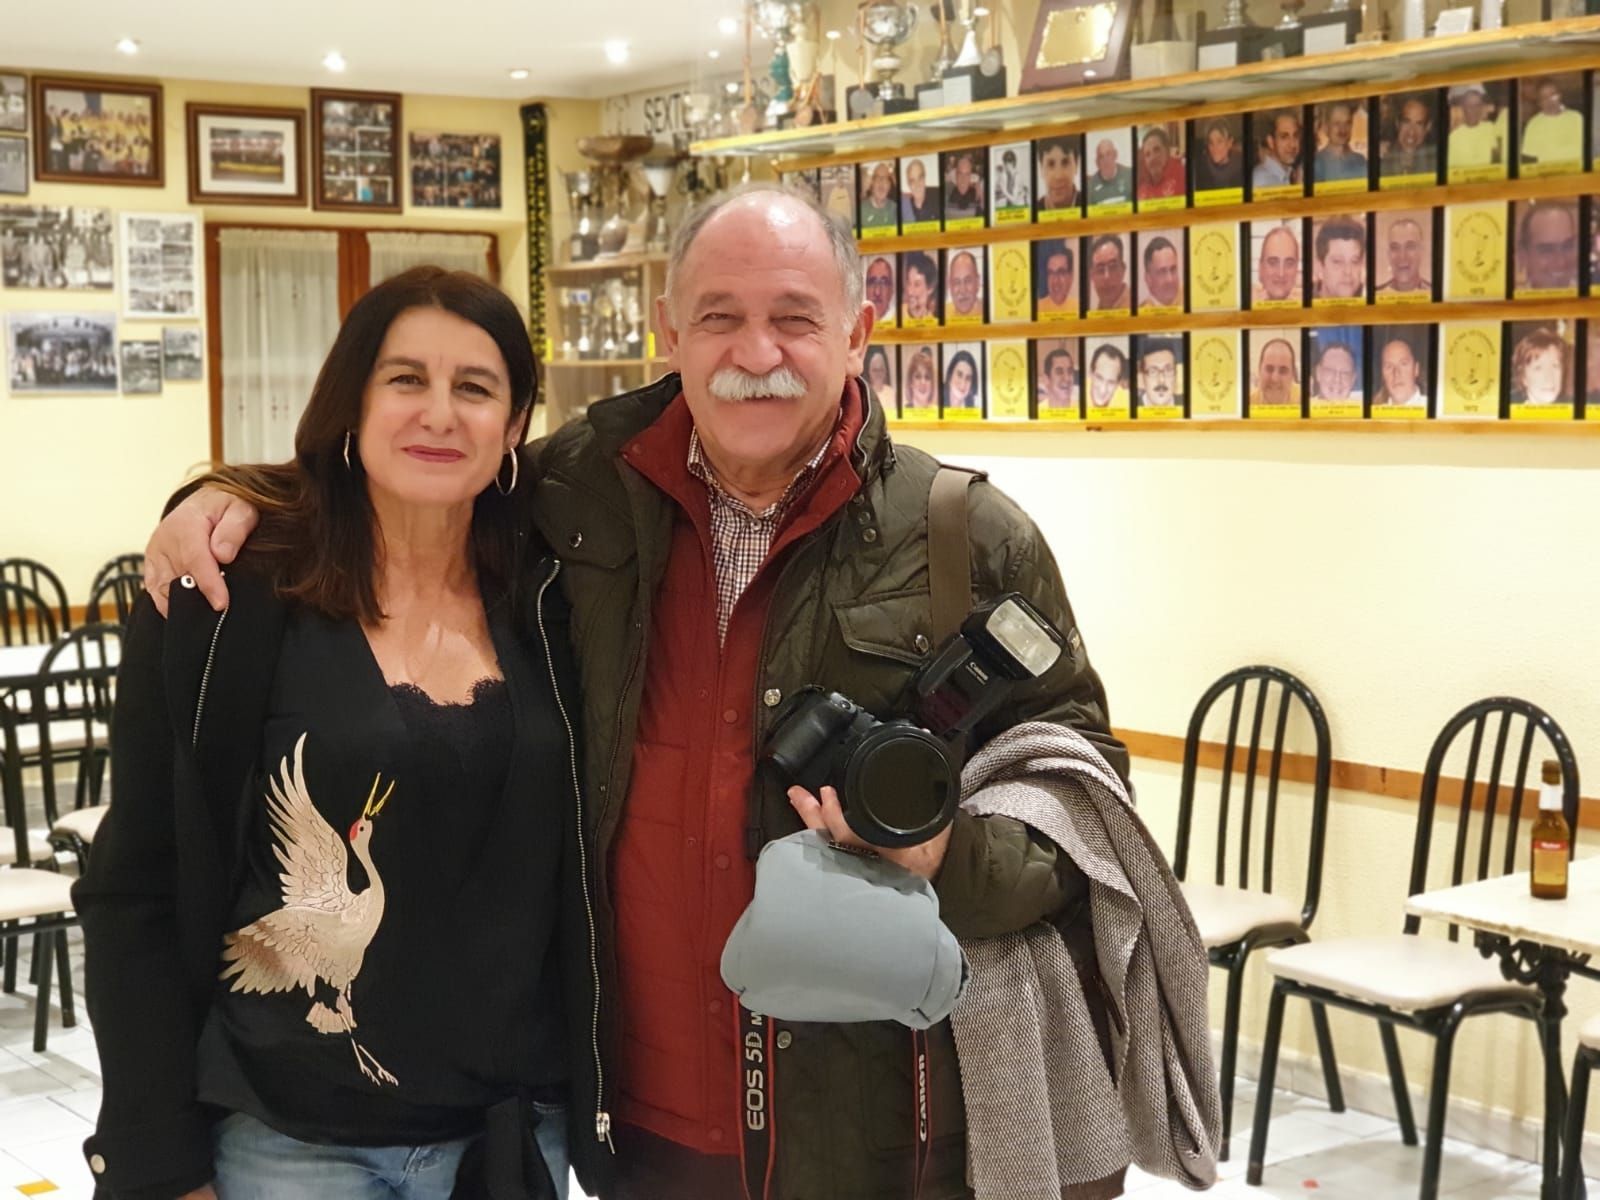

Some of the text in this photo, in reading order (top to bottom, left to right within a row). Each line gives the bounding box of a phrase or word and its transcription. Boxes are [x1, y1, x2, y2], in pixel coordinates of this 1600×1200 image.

[745, 1031, 763, 1063] 5D
[746, 1069, 765, 1130] EOS
[918, 1054, 927, 1142] Canon
